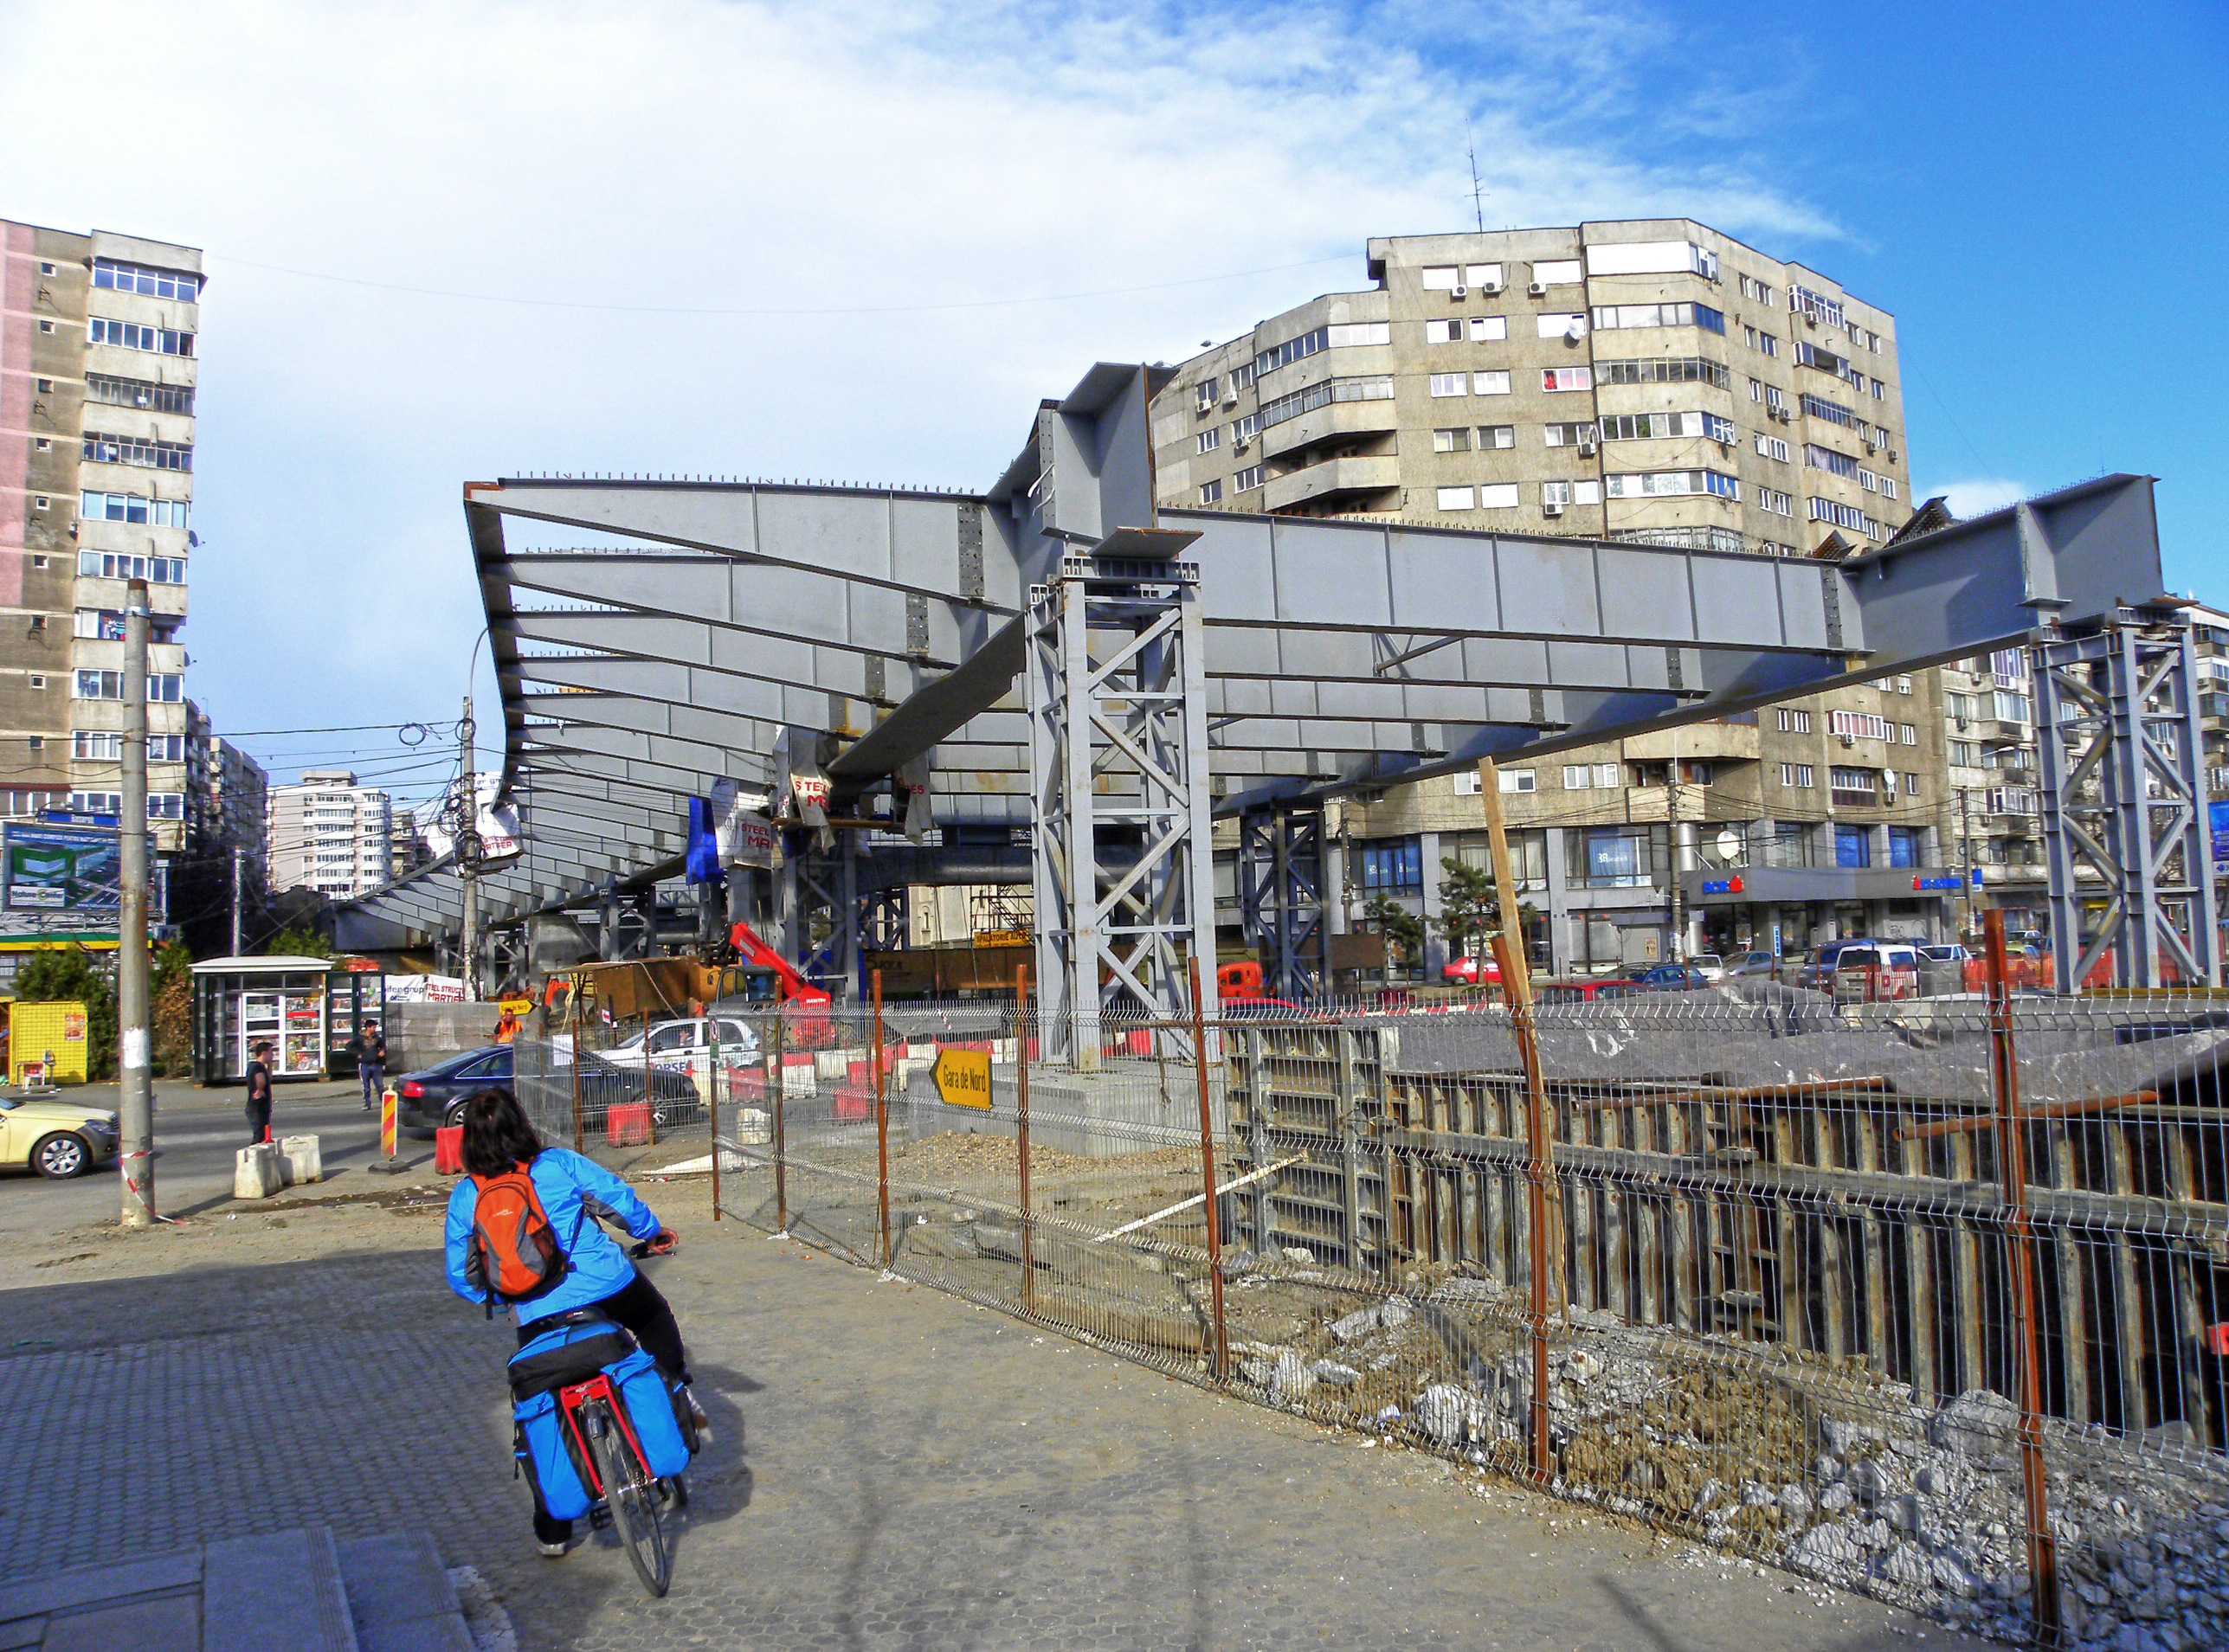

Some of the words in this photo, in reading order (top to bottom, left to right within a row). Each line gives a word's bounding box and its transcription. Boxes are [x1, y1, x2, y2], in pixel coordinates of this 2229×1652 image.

[742, 823, 770, 837] STEEL
[944, 1064, 960, 1089] Gara
[960, 1066, 969, 1090] de
[970, 1067, 986, 1092] Nord
